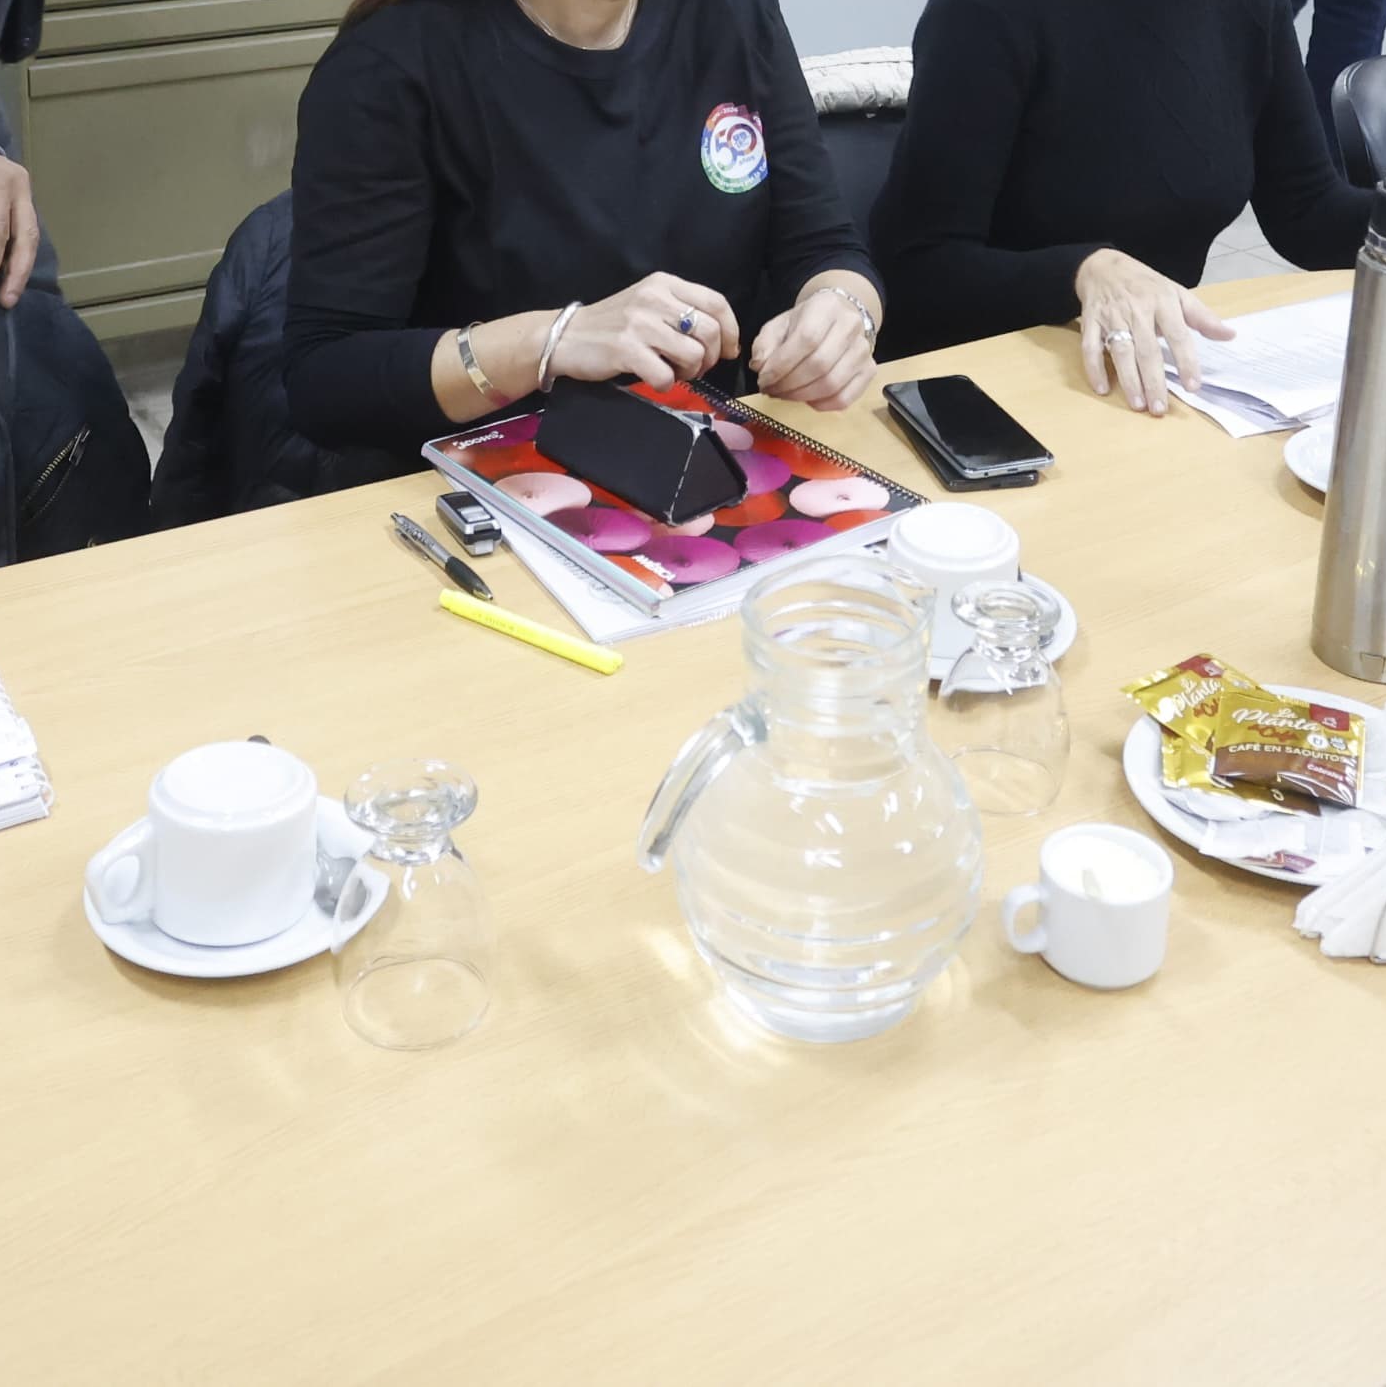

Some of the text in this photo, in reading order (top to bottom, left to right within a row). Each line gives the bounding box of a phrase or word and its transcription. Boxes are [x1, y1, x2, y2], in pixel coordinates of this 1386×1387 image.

[1231, 707, 1319, 732] Planta
[1228, 742, 1261, 753] CAFÉ
[1263, 745, 1282, 753] EN
